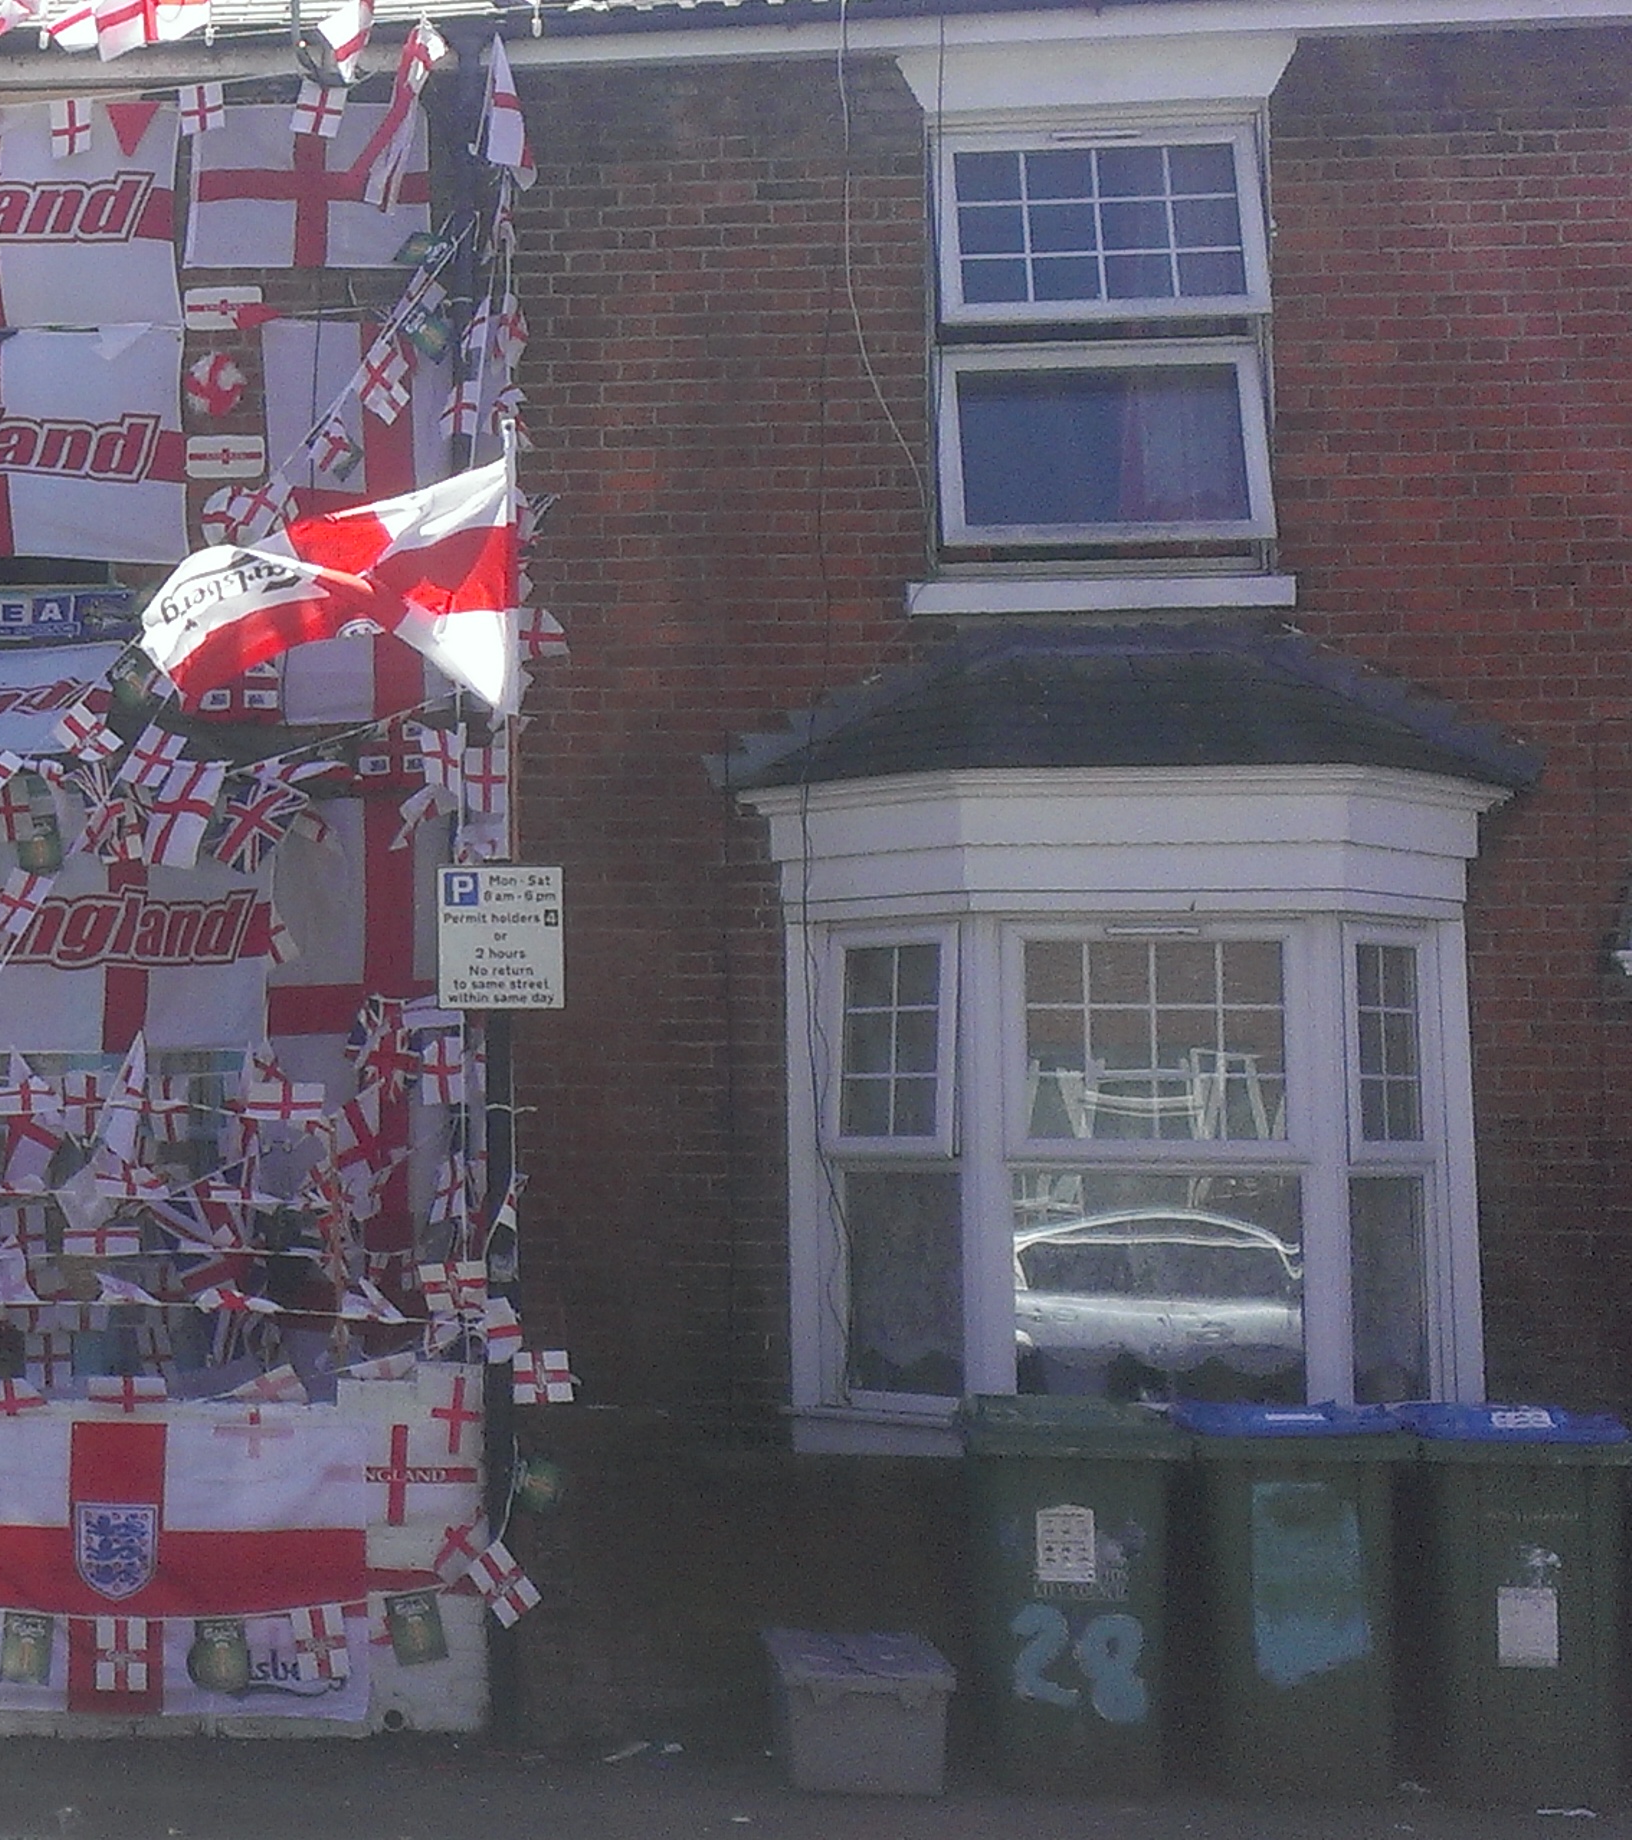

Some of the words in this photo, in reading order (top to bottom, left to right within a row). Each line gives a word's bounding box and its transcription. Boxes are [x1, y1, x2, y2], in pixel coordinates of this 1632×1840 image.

[489, 875, 517, 886] Mon
[527, 875, 552, 886] Sat
[452, 876, 475, 904] P
[495, 892, 515, 902] am
[536, 892, 556, 903] pm
[443, 913, 487, 924] Permit
[491, 913, 541, 924] holders
[494, 932, 508, 941] or
[475, 948, 485, 959] 2
[489, 947, 526, 959] hours
[469, 965, 488, 976] No
[492, 966, 534, 976] return
[453, 979, 467, 990] to
[471, 981, 505, 990] same
[510, 978, 549, 990] street
[448, 992, 489, 1003] within
[493, 994, 527, 1003] same
[531, 992, 555, 1005] day
[363, 1467, 447, 1483] NGLAND
[1011, 1604, 1147, 1723] 28
